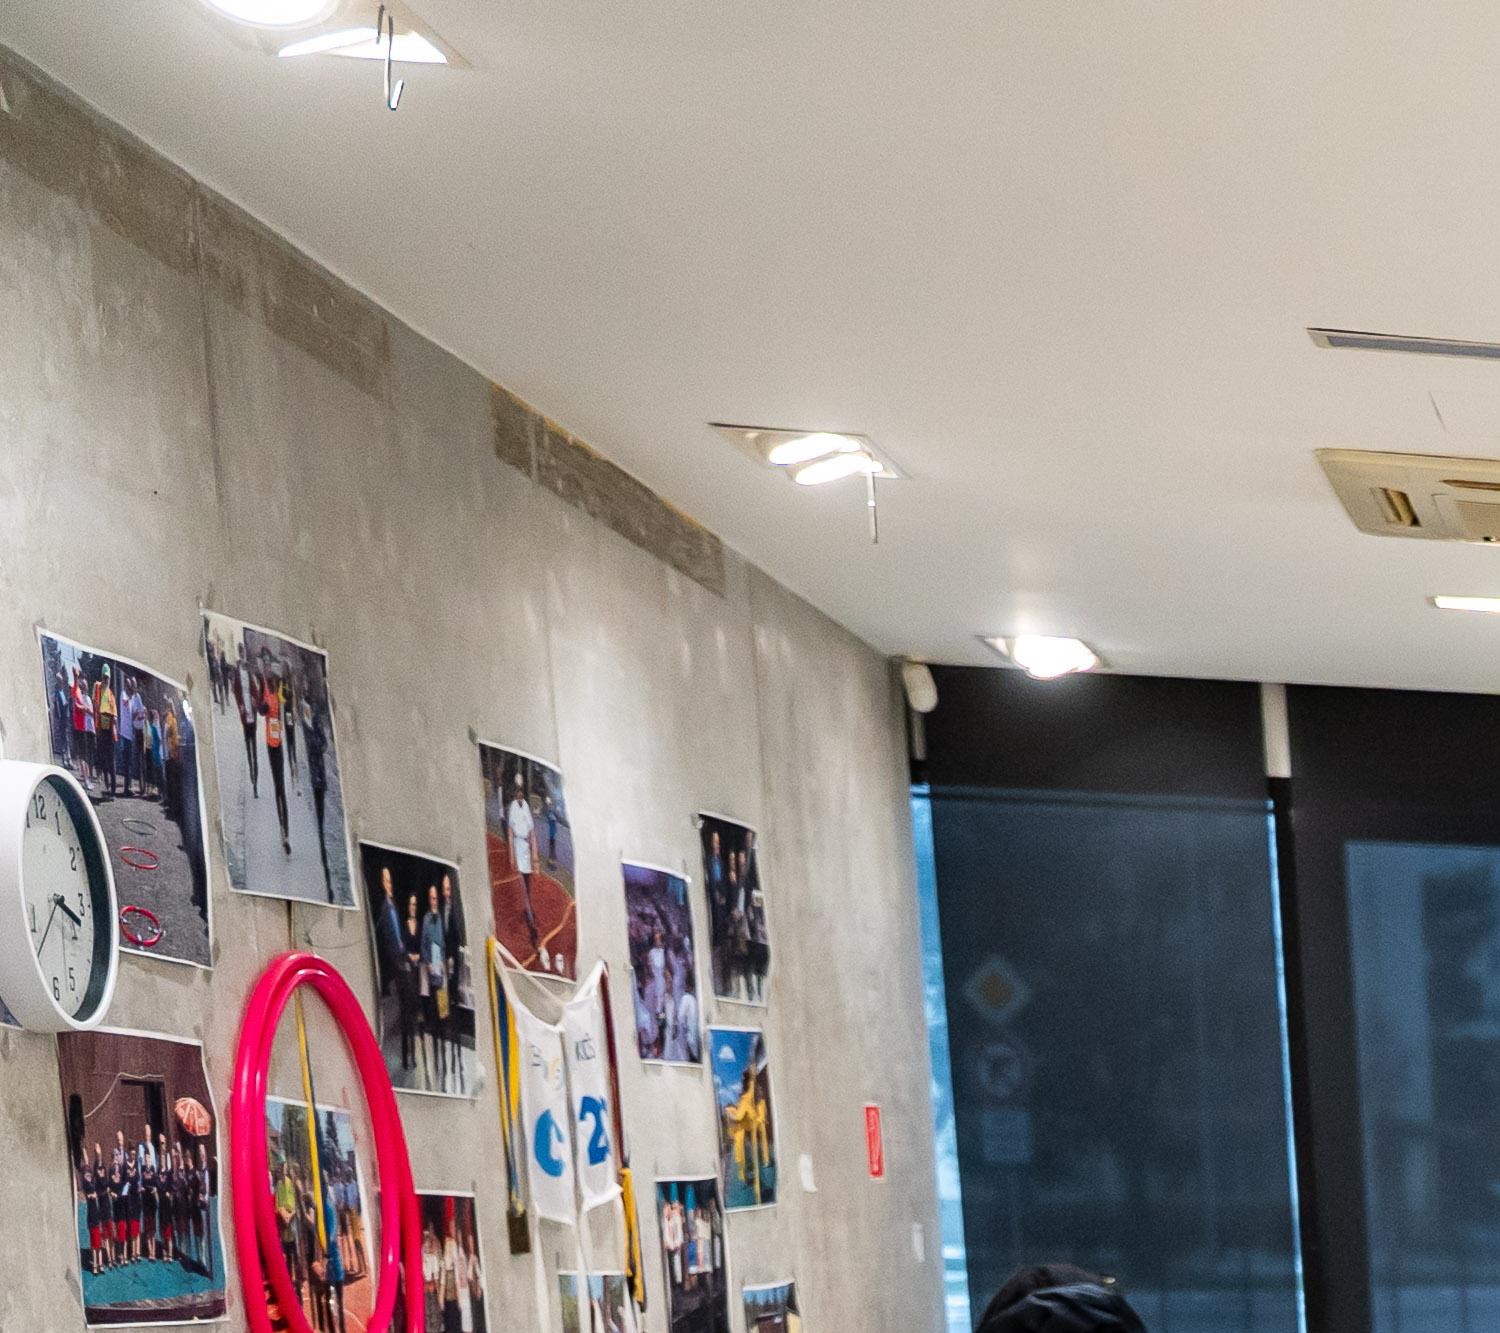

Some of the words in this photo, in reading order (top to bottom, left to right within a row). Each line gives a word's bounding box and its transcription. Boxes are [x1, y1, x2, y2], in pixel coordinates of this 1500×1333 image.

[34, 794, 47, 820] 12
[55, 811, 61, 836] 1
[69, 846, 77, 871] 2
[77, 892, 85, 917] 3
[53, 976, 60, 1001] 6
[68, 967, 76, 992] 5
